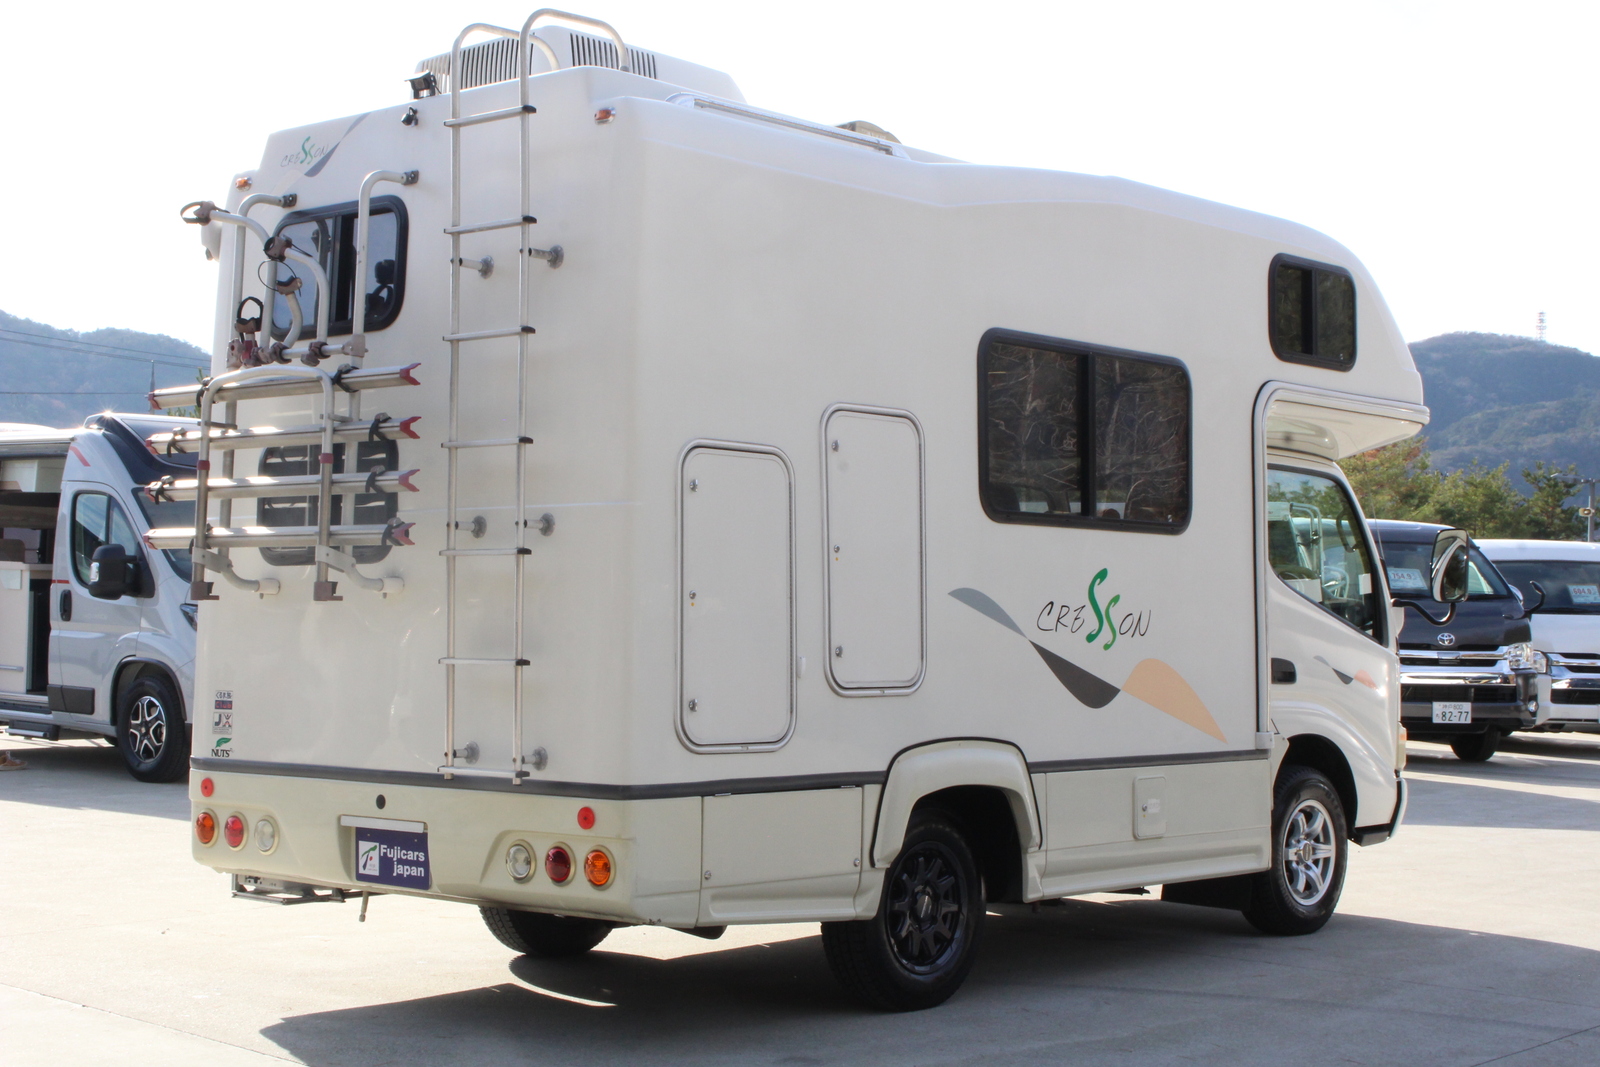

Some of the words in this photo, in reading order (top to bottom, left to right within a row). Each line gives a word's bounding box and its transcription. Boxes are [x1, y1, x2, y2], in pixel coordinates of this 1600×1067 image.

[280, 136, 329, 167] CRESSON
[1037, 568, 1151, 651] CRESSON
[1441, 711, 1469, 721] 82-77
[211, 748, 230, 758] NUTS
[380, 844, 426, 862] Fujicars
[392, 861, 425, 878] japan
